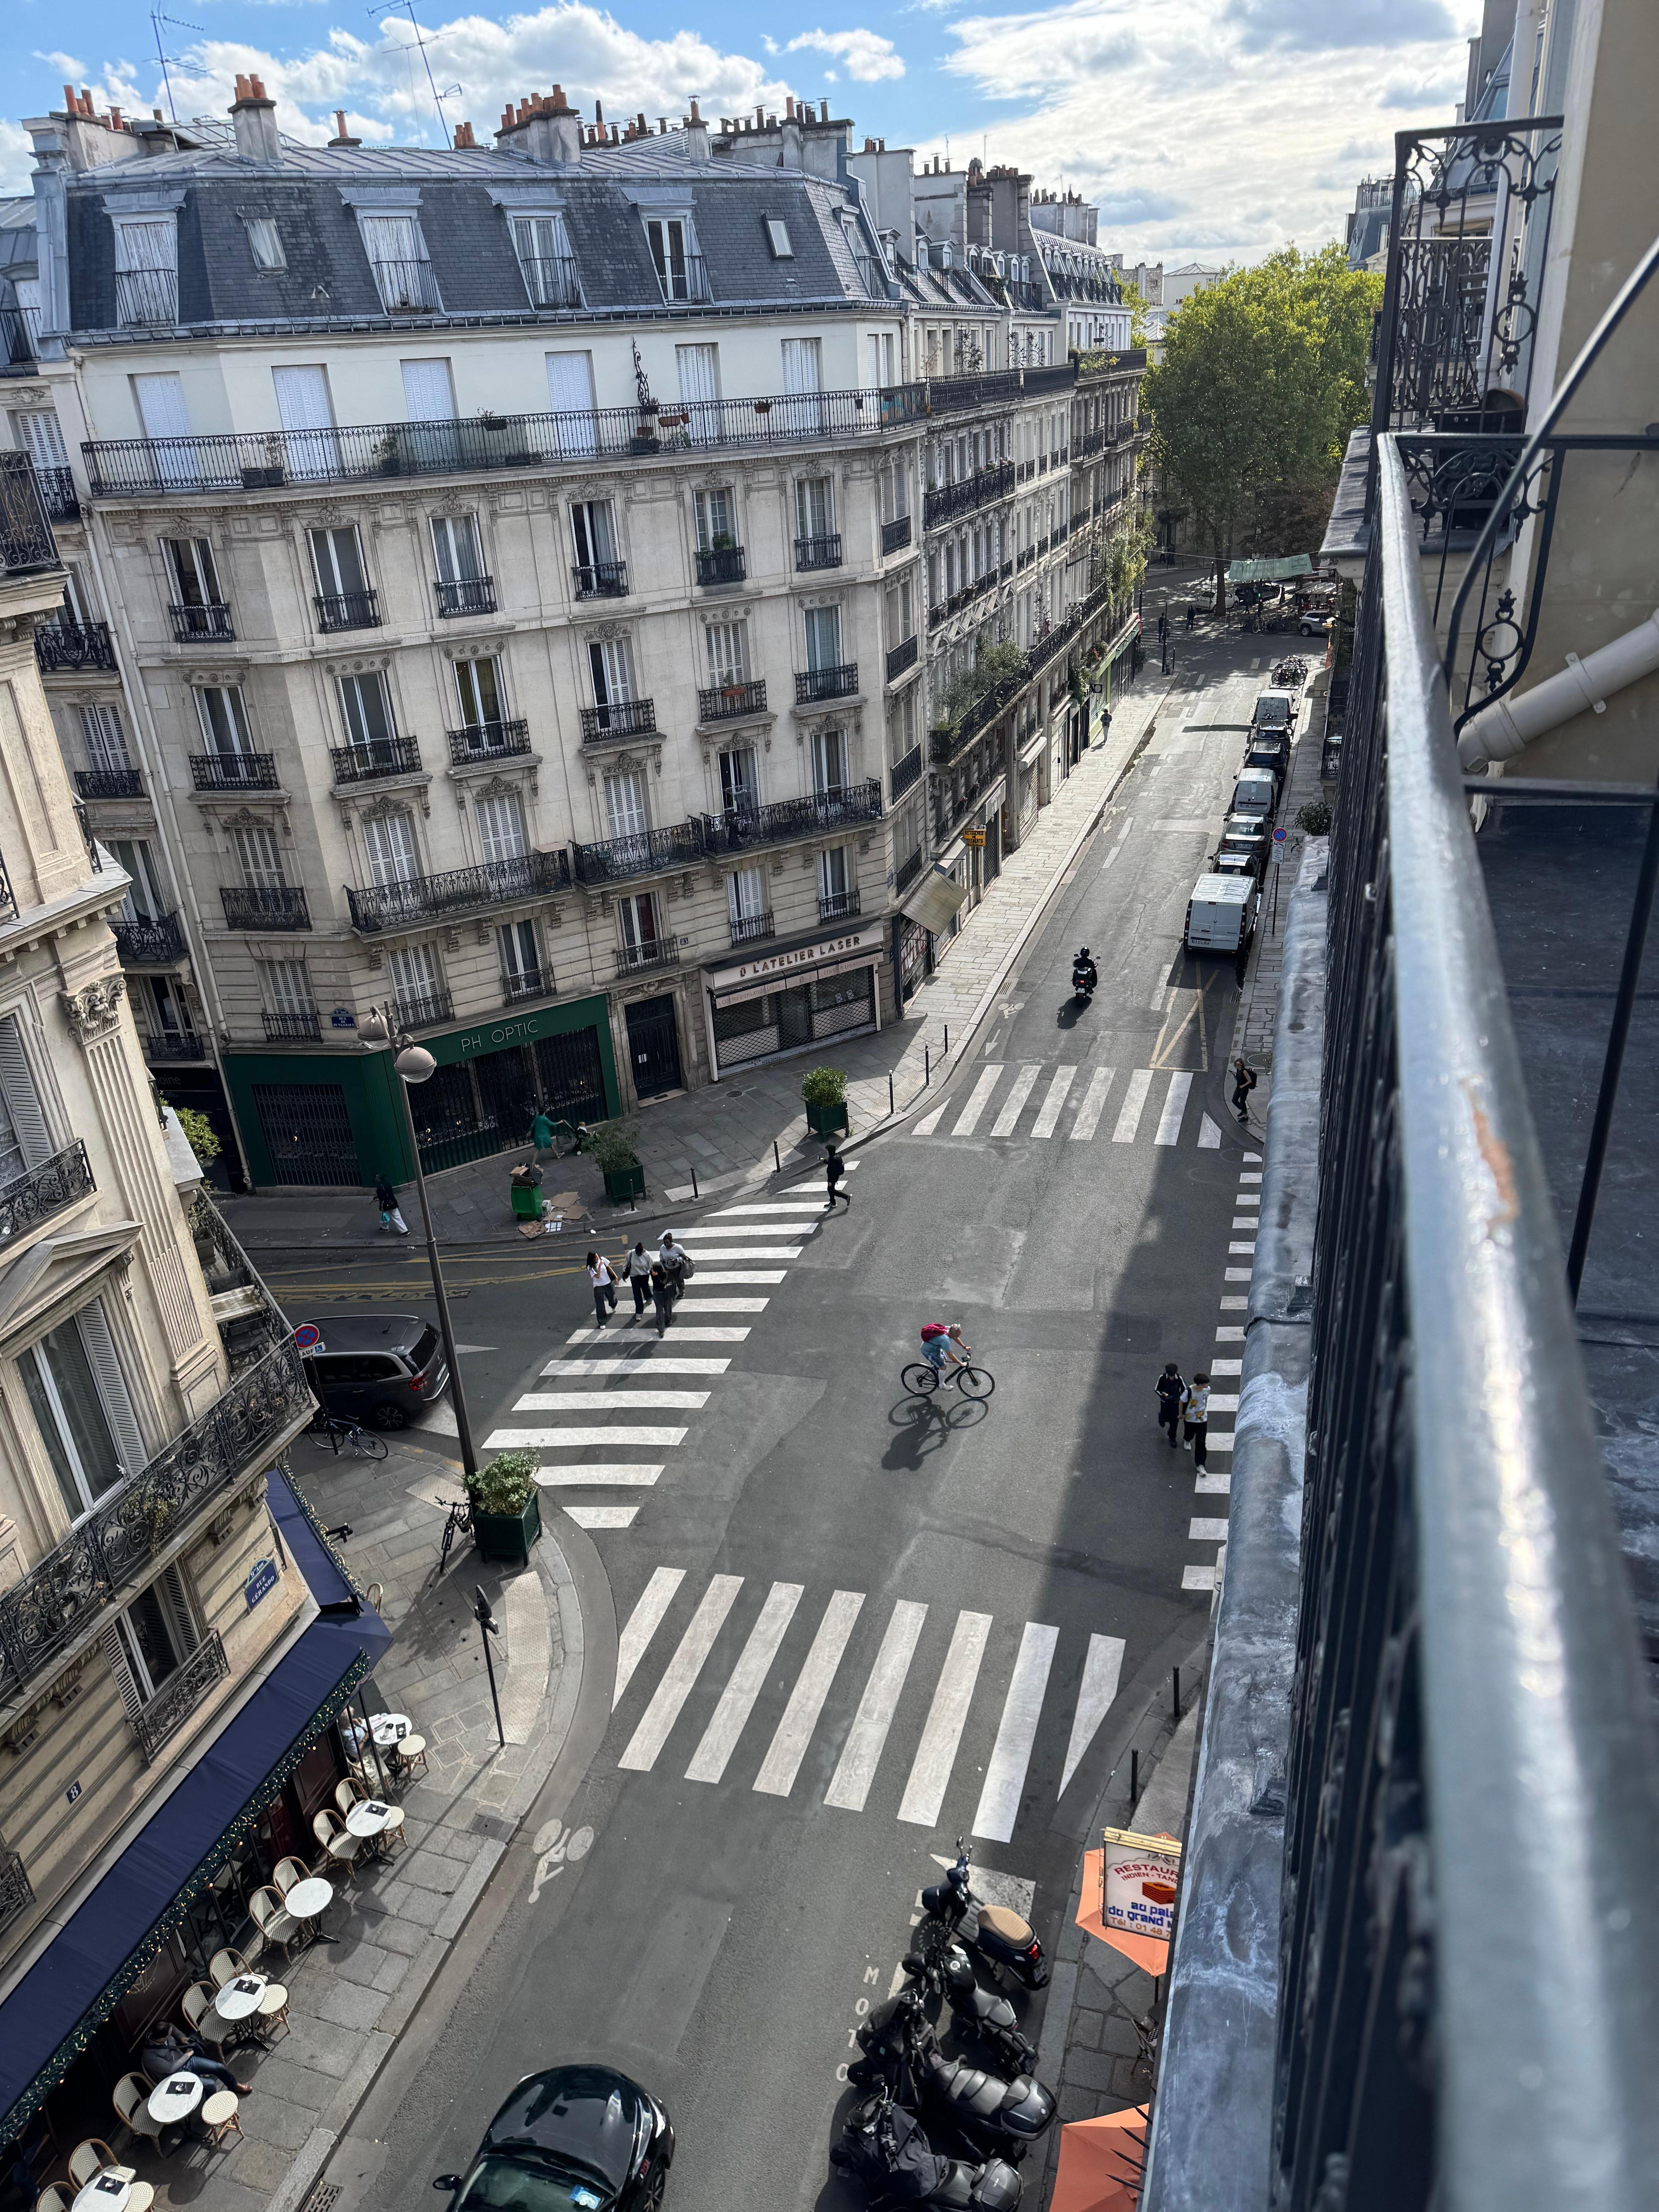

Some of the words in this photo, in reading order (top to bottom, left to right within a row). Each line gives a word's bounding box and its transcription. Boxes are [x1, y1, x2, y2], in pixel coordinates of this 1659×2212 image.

[753, 948, 814, 974] L'ATELIER
[820, 936, 860, 955] LASER
[461, 1034, 481, 1052] PH
[491, 1020, 538, 1043] OPTIC
[300, 1348, 314, 1357] AUF
[252, 1575, 275, 1603] GÉRANDO
[256, 1575, 266, 1589] RUE
[70, 1786, 79, 1799] 8
[1121, 1872, 1149, 1881] INDIEN
[1132, 1902, 1146, 1912] au
[1109, 1906, 1123, 1917] du
[1127, 1911, 1164, 1926] grand
[1111, 1917, 1126, 1926] Tél
[1136, 1923, 1147, 1931] 01
[1150, 1927, 1163, 1935] 48
